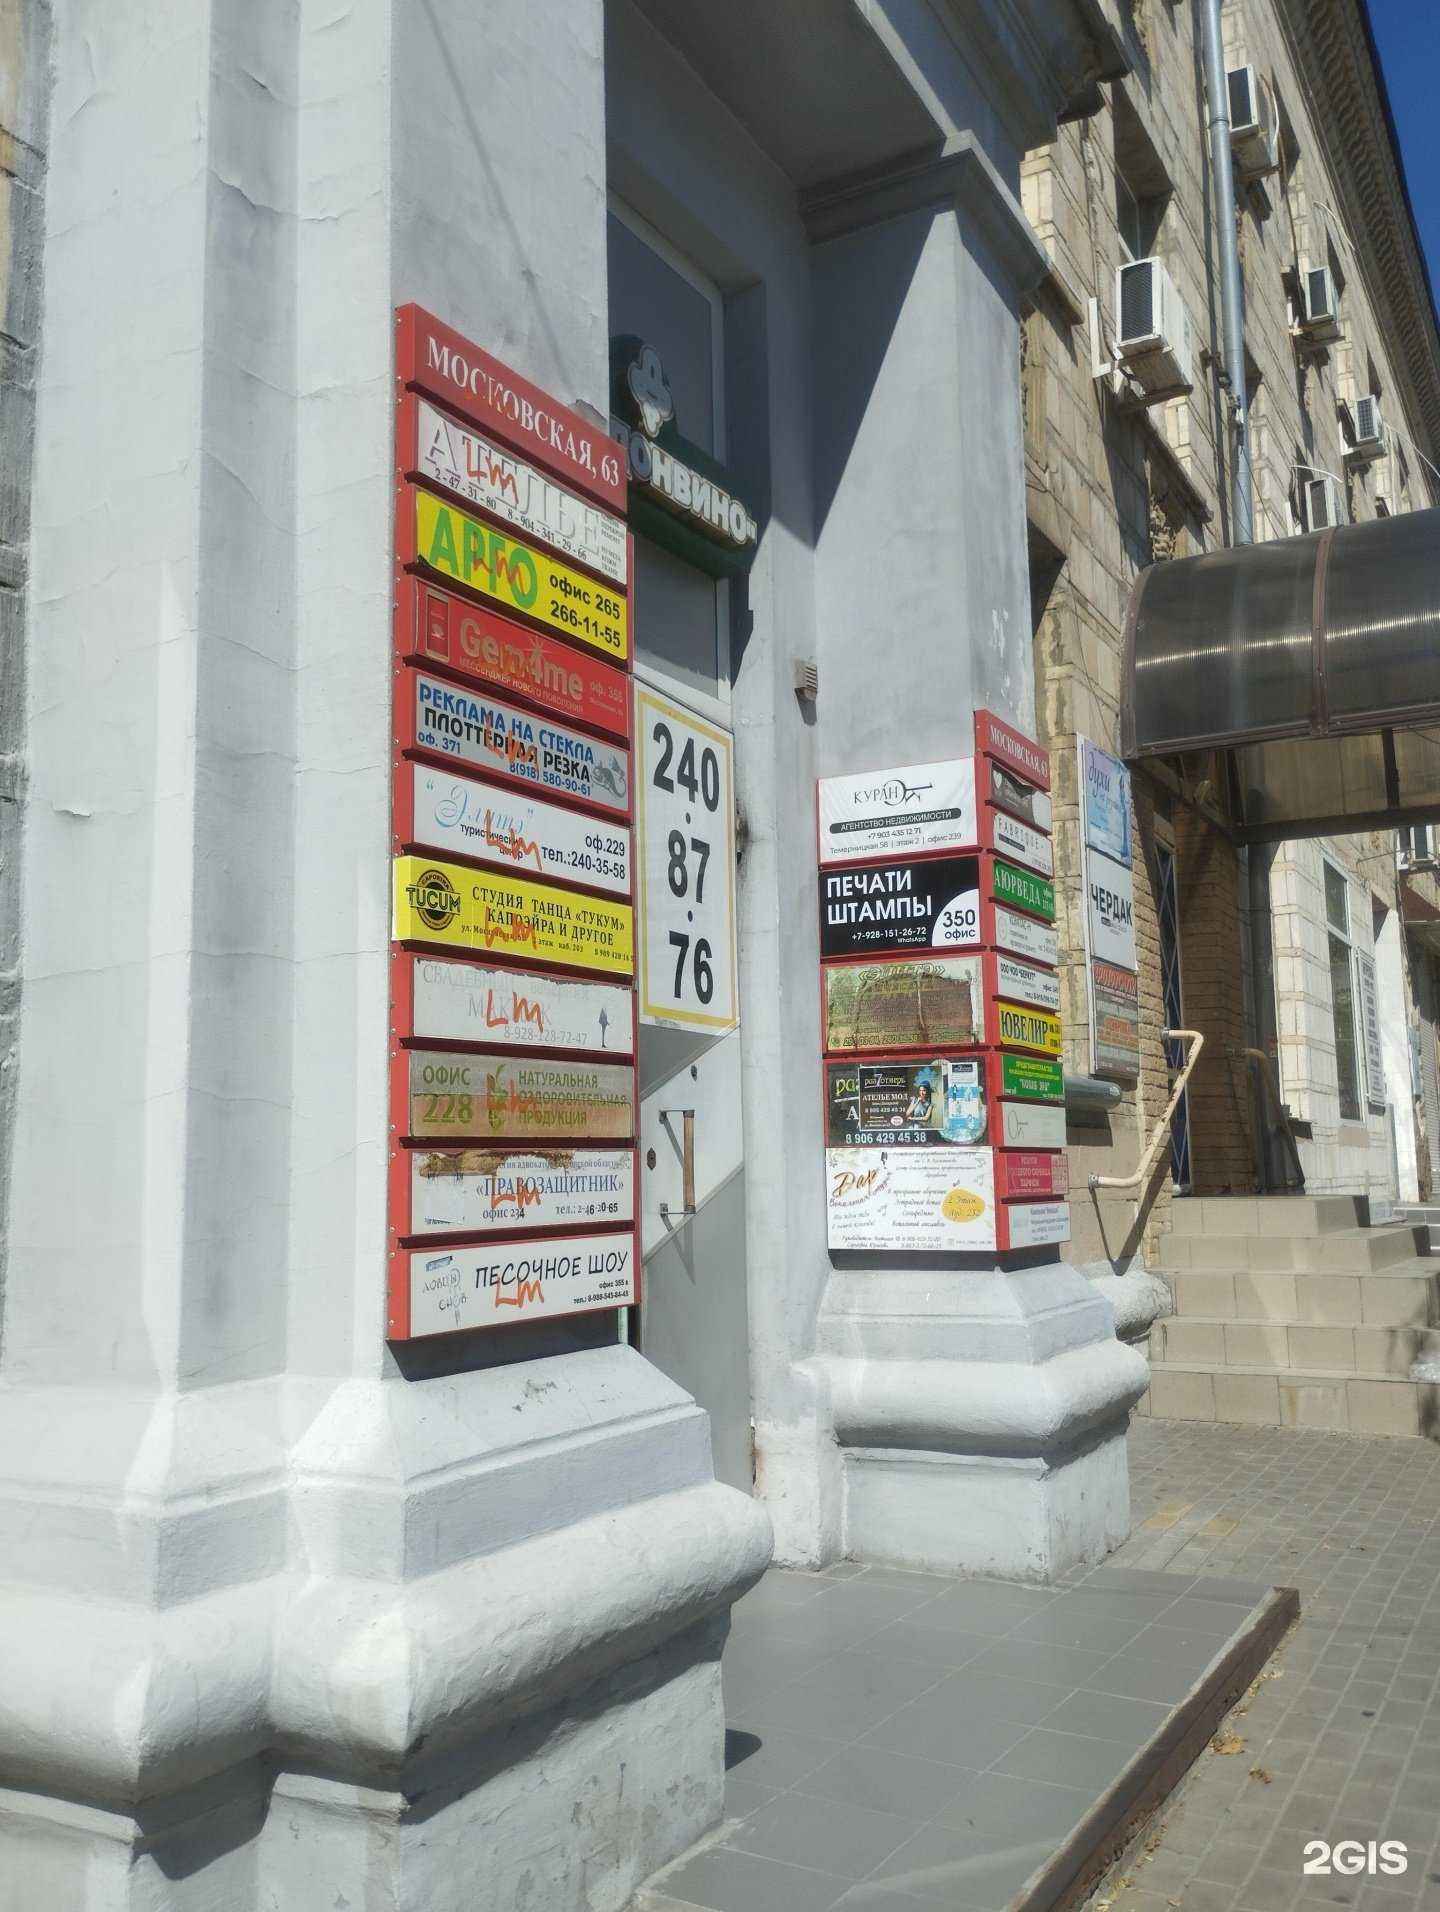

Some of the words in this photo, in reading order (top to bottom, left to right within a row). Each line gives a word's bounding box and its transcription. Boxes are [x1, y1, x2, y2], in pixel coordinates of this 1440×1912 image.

[426, 336, 597, 479] МОСКОВСКАЯ,
[600, 455, 620, 486] 63
[429, 507, 538, 610] АРГО
[549, 574, 591, 605] офис
[595, 594, 621, 620] 265
[550, 600, 621, 648] 266-11-55
[419, 683, 506, 733] РЕКЛАМА
[511, 718, 534, 743] НА
[538, 730, 594, 765] СТЕКЛА
[418, 730, 438, 747] оф.
[441, 738, 461, 754] 371
[543, 751, 591, 783] РЕЗКА
[653, 722, 720, 813] 240
[542, 770, 591, 797] 580-90-61
[840, 818, 885, 832] АГЕНТСТВО
[885, 810, 953, 827] НЕДВИЖИМОСТИ
[585, 834, 625, 858] оф.229
[927, 835, 948, 845] офис
[541, 846, 626, 881] тел.:240-35-58
[668, 829, 711, 904] 87
[827, 870, 912, 898] ПЕЧАТИ
[995, 866, 1041, 906] АЮРВЕДА
[406, 887, 461, 913] TUCUM
[472, 886, 524, 910] СТУДИЯ
[531, 899, 572, 920] ТАНЦА
[575, 910, 625, 931] «ТУКУМ»
[827, 895, 932, 925] ШТАМПЫ
[1090, 883, 1132, 927] ЧЕРДАК
[943, 909, 976, 928] 350
[559, 925, 567, 936] И
[571, 925, 614, 946] ДРУГОЕ
[852, 926, 927, 941] +7-928-151-26-72
[944, 929, 976, 941] офис
[669, 930, 714, 1005] 76
[1001, 1010, 1048, 1045] ЮВЕЛИР
[422, 1066, 472, 1086] ОФИС
[518, 1070, 598, 1088] НАТУРАЛЬНАЯ
[423, 1096, 473, 1124] 228
[863, 1093, 890, 1101] АТЕЛЬЕ
[518, 1110, 588, 1127] ПРОДУКЦИЯ
[845, 1133, 852, 1144] 8
[854, 1132, 873, 1144] 906
[876, 1132, 895, 1143] 429
[897, 1132, 911, 1143] 45
[914, 1131, 927, 1142] 38
[476, 1174, 624, 1199] «ПРАВОЗАЩИТНИК»
[482, 1207, 508, 1223] офис
[555, 1203, 576, 1215] тел.:
[475, 1257, 582, 1288] ПЕСОЧНОЕ
[588, 1251, 629, 1276] ШОУ
